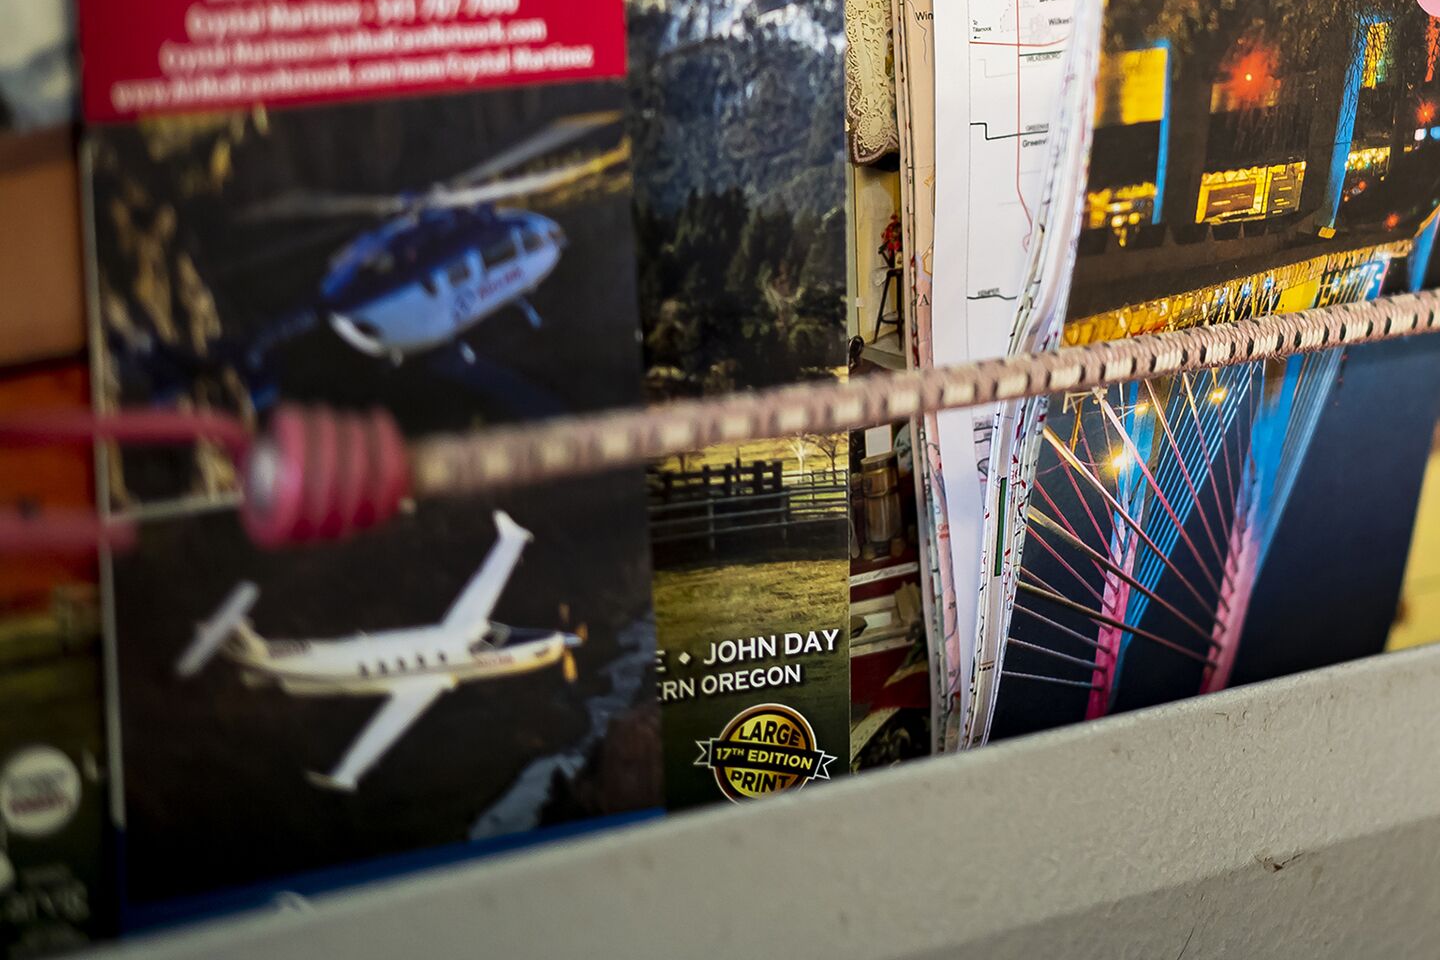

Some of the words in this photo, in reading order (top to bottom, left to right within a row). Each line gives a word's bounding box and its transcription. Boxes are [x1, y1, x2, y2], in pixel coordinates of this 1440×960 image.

[703, 635, 776, 666] JOHN
[784, 628, 839, 655] DAY
[701, 664, 801, 694] OREGON
[739, 720, 801, 747] LARGE
[747, 749, 813, 771] EDITION
[730, 770, 791, 793] PRINT
